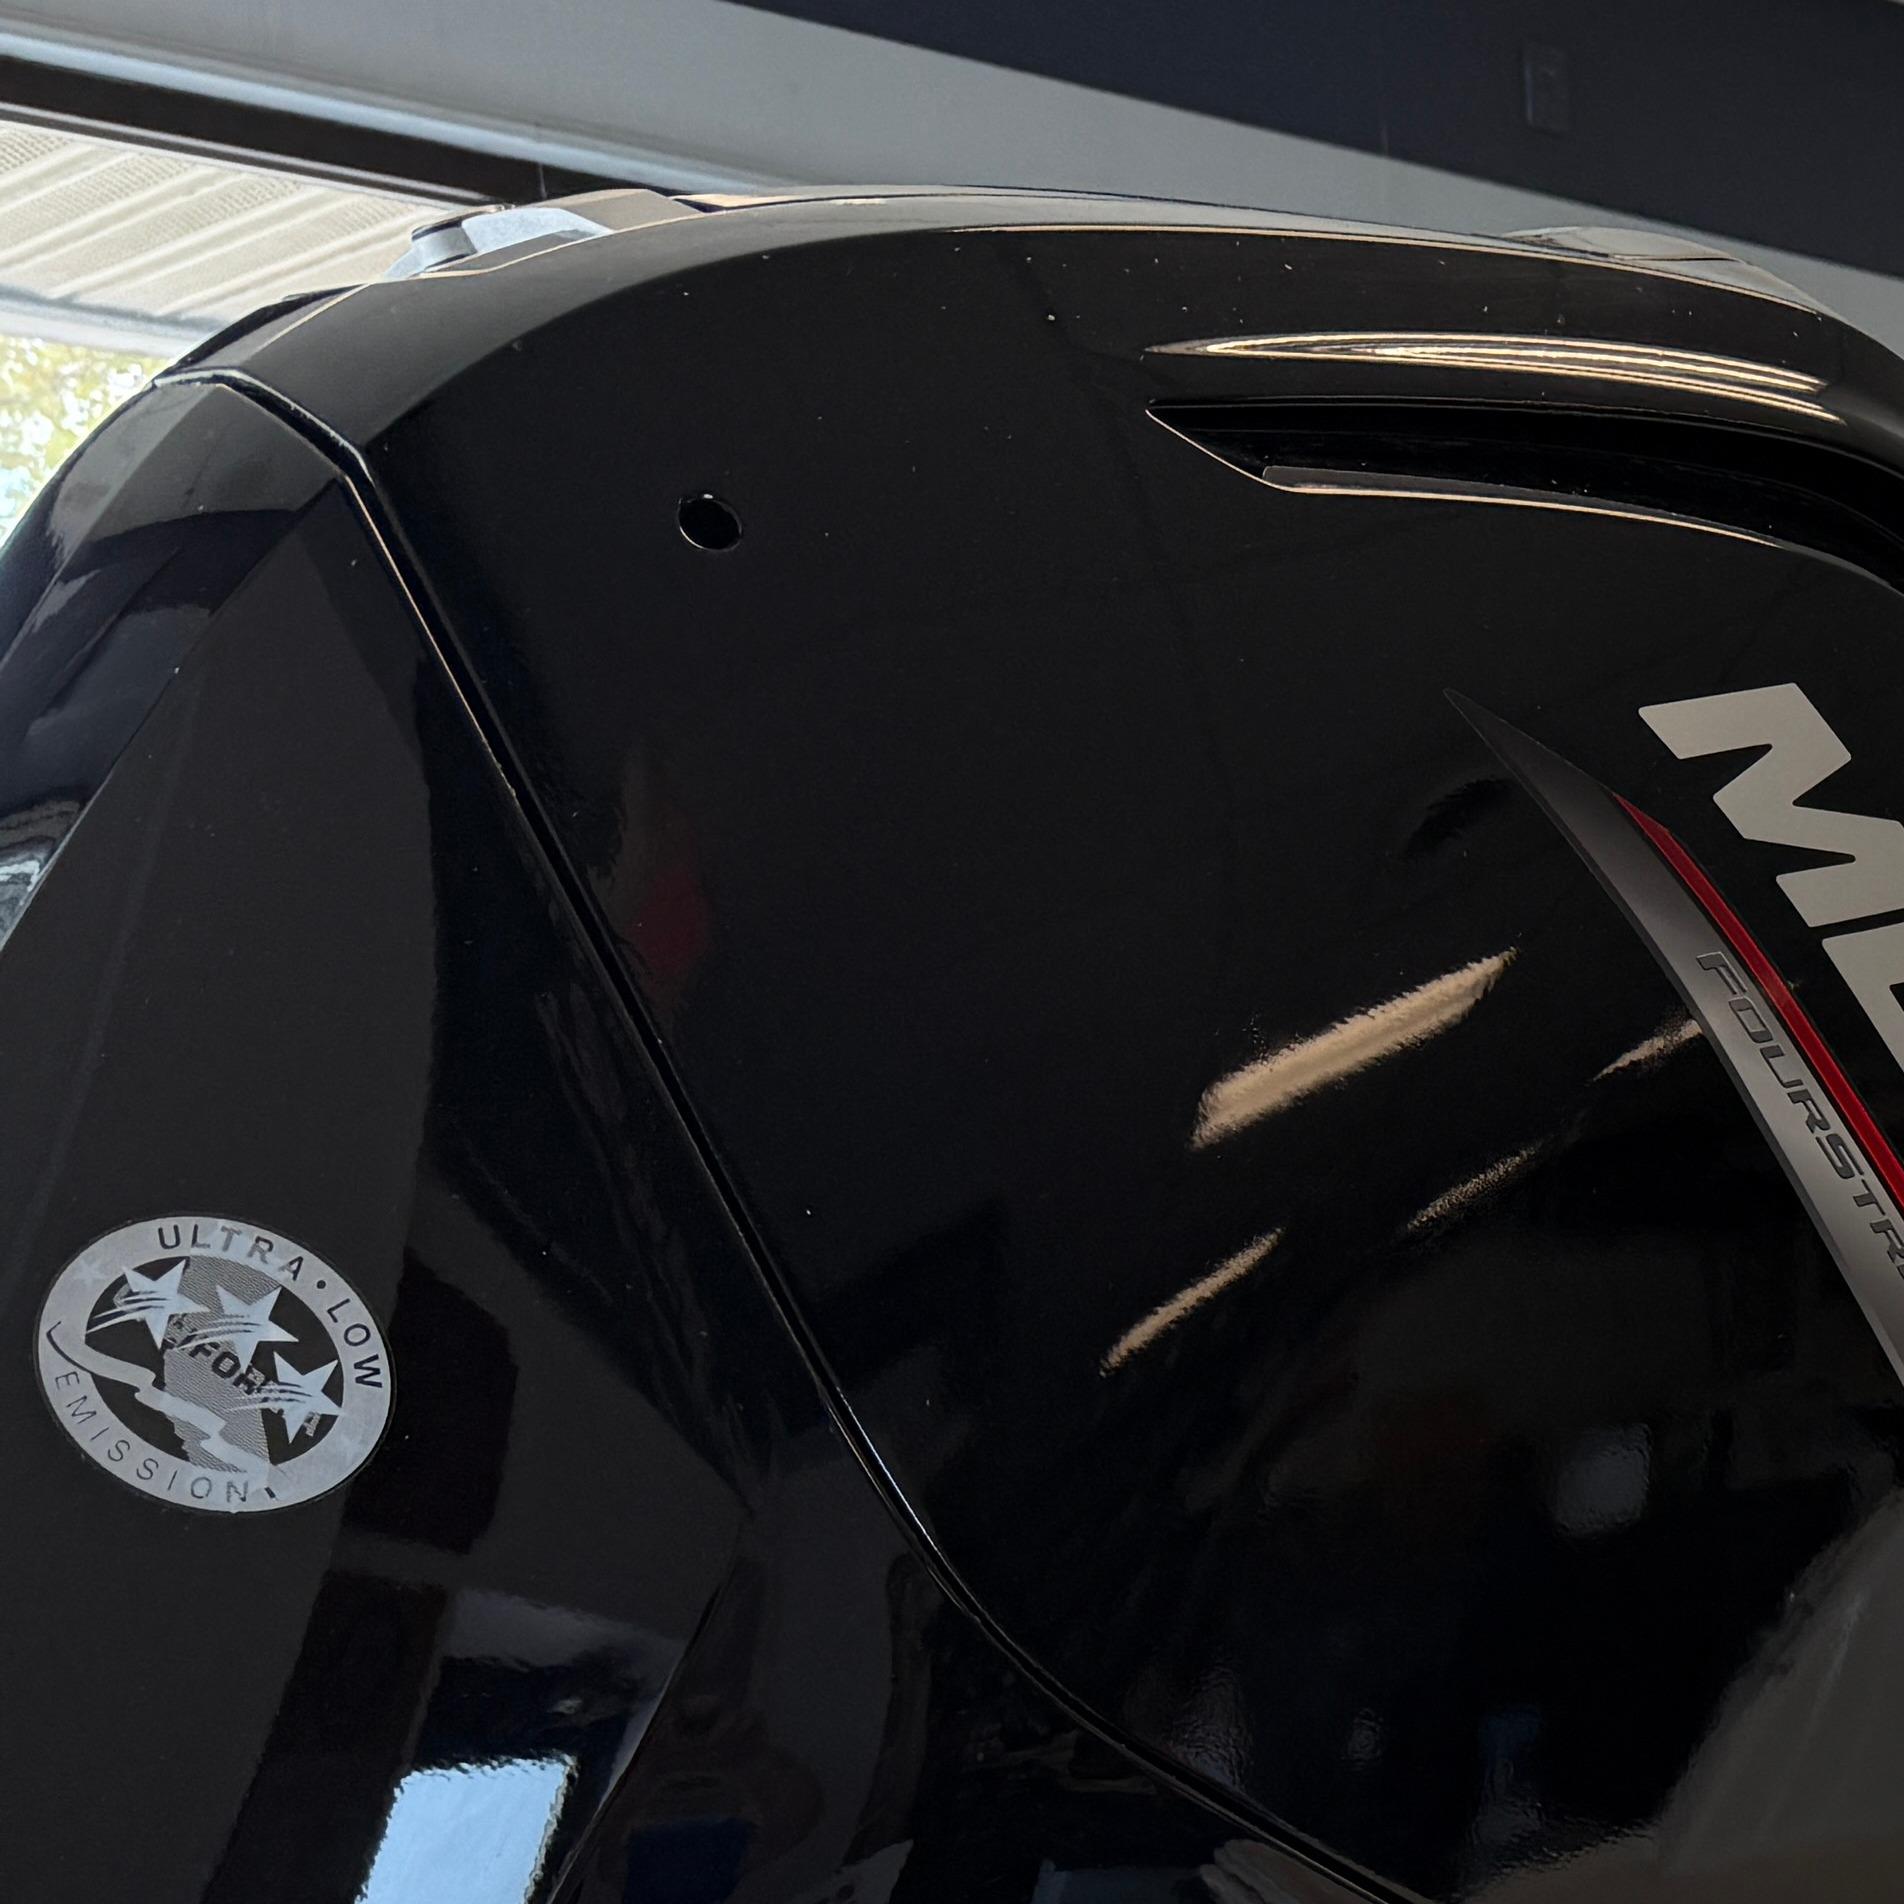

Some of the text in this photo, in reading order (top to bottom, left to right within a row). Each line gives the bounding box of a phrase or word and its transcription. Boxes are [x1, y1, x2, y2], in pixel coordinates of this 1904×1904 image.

[157, 1223, 304, 1282] ULTRA
[326, 1297, 384, 1389] LOW
[54, 1370, 250, 1503] EMISSION
